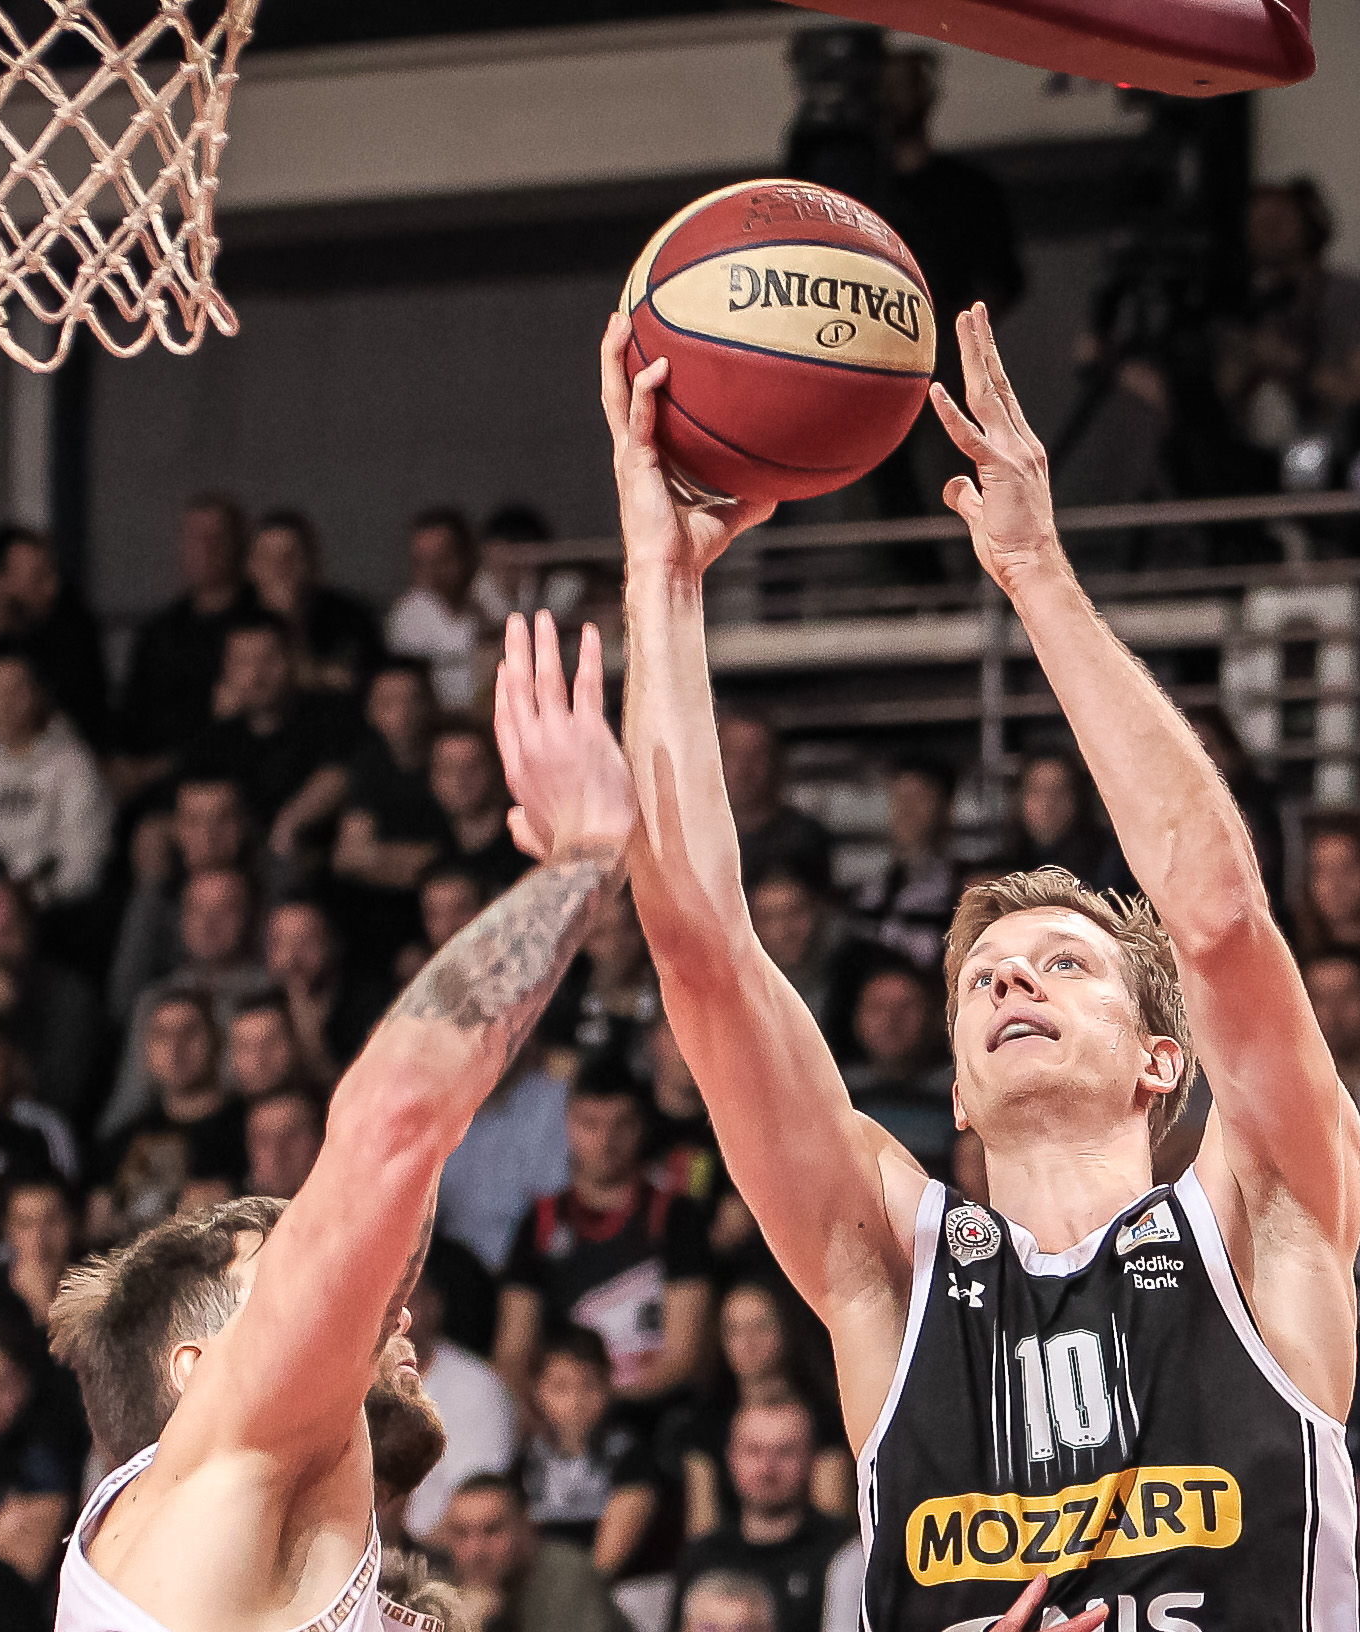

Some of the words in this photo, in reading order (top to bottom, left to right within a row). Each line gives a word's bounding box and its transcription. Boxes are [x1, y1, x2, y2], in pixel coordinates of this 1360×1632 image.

[729, 263, 921, 343] SPALDING
[1123, 1255, 1184, 1274] Addiko
[1133, 1273, 1179, 1290] Bank
[1015, 1329, 1112, 1462] 10
[918, 1480, 1228, 1573] MOZZART
